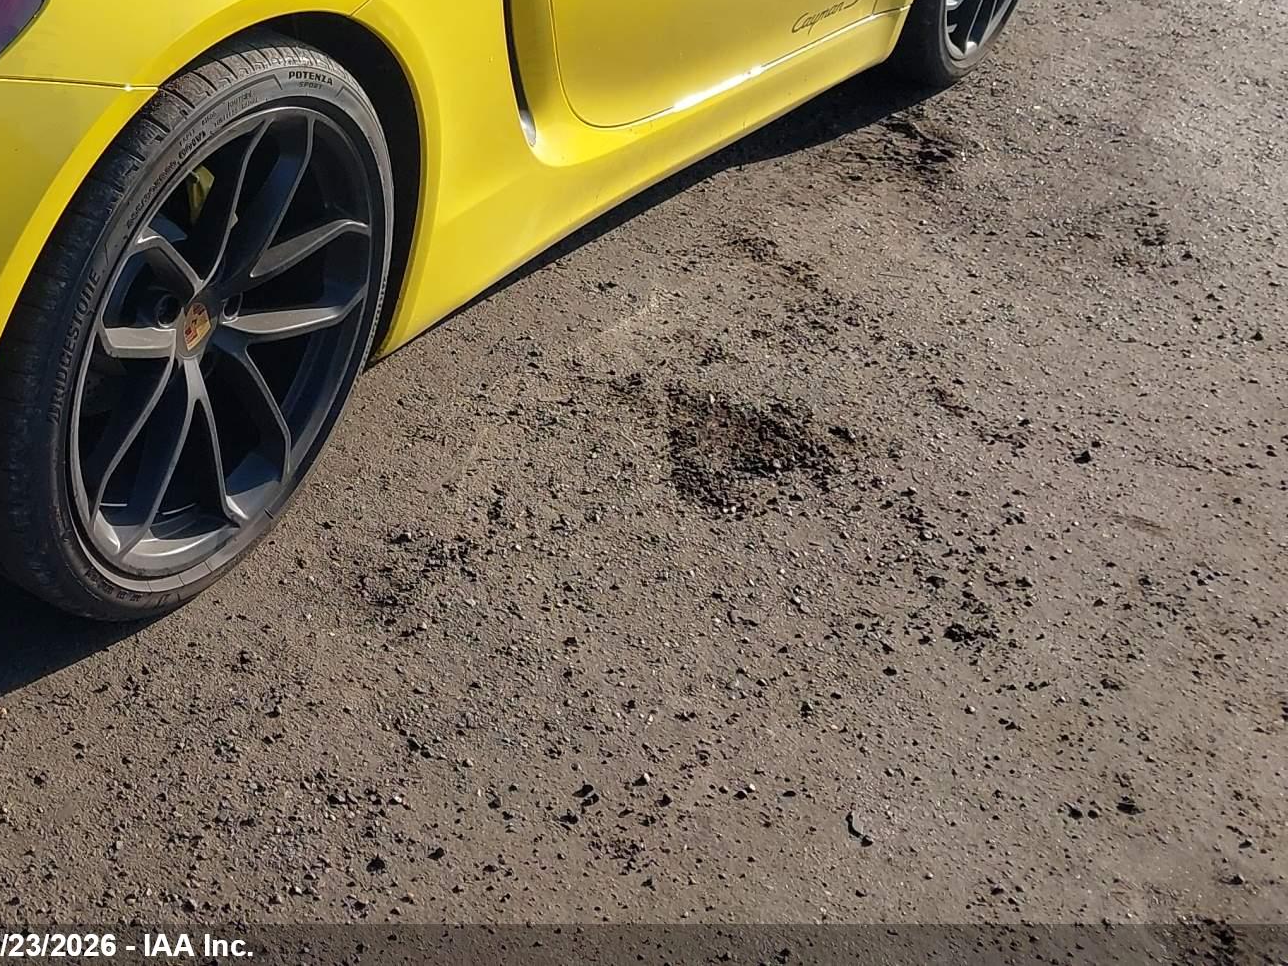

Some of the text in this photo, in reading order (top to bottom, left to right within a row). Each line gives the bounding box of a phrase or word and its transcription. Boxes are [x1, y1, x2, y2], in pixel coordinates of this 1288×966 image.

[791, 0, 844, 35] Cayman
[288, 70, 334, 86] POTENZA
[298, 81, 323, 90] SPORT
[47, 268, 101, 426] BRIDGESTONE
